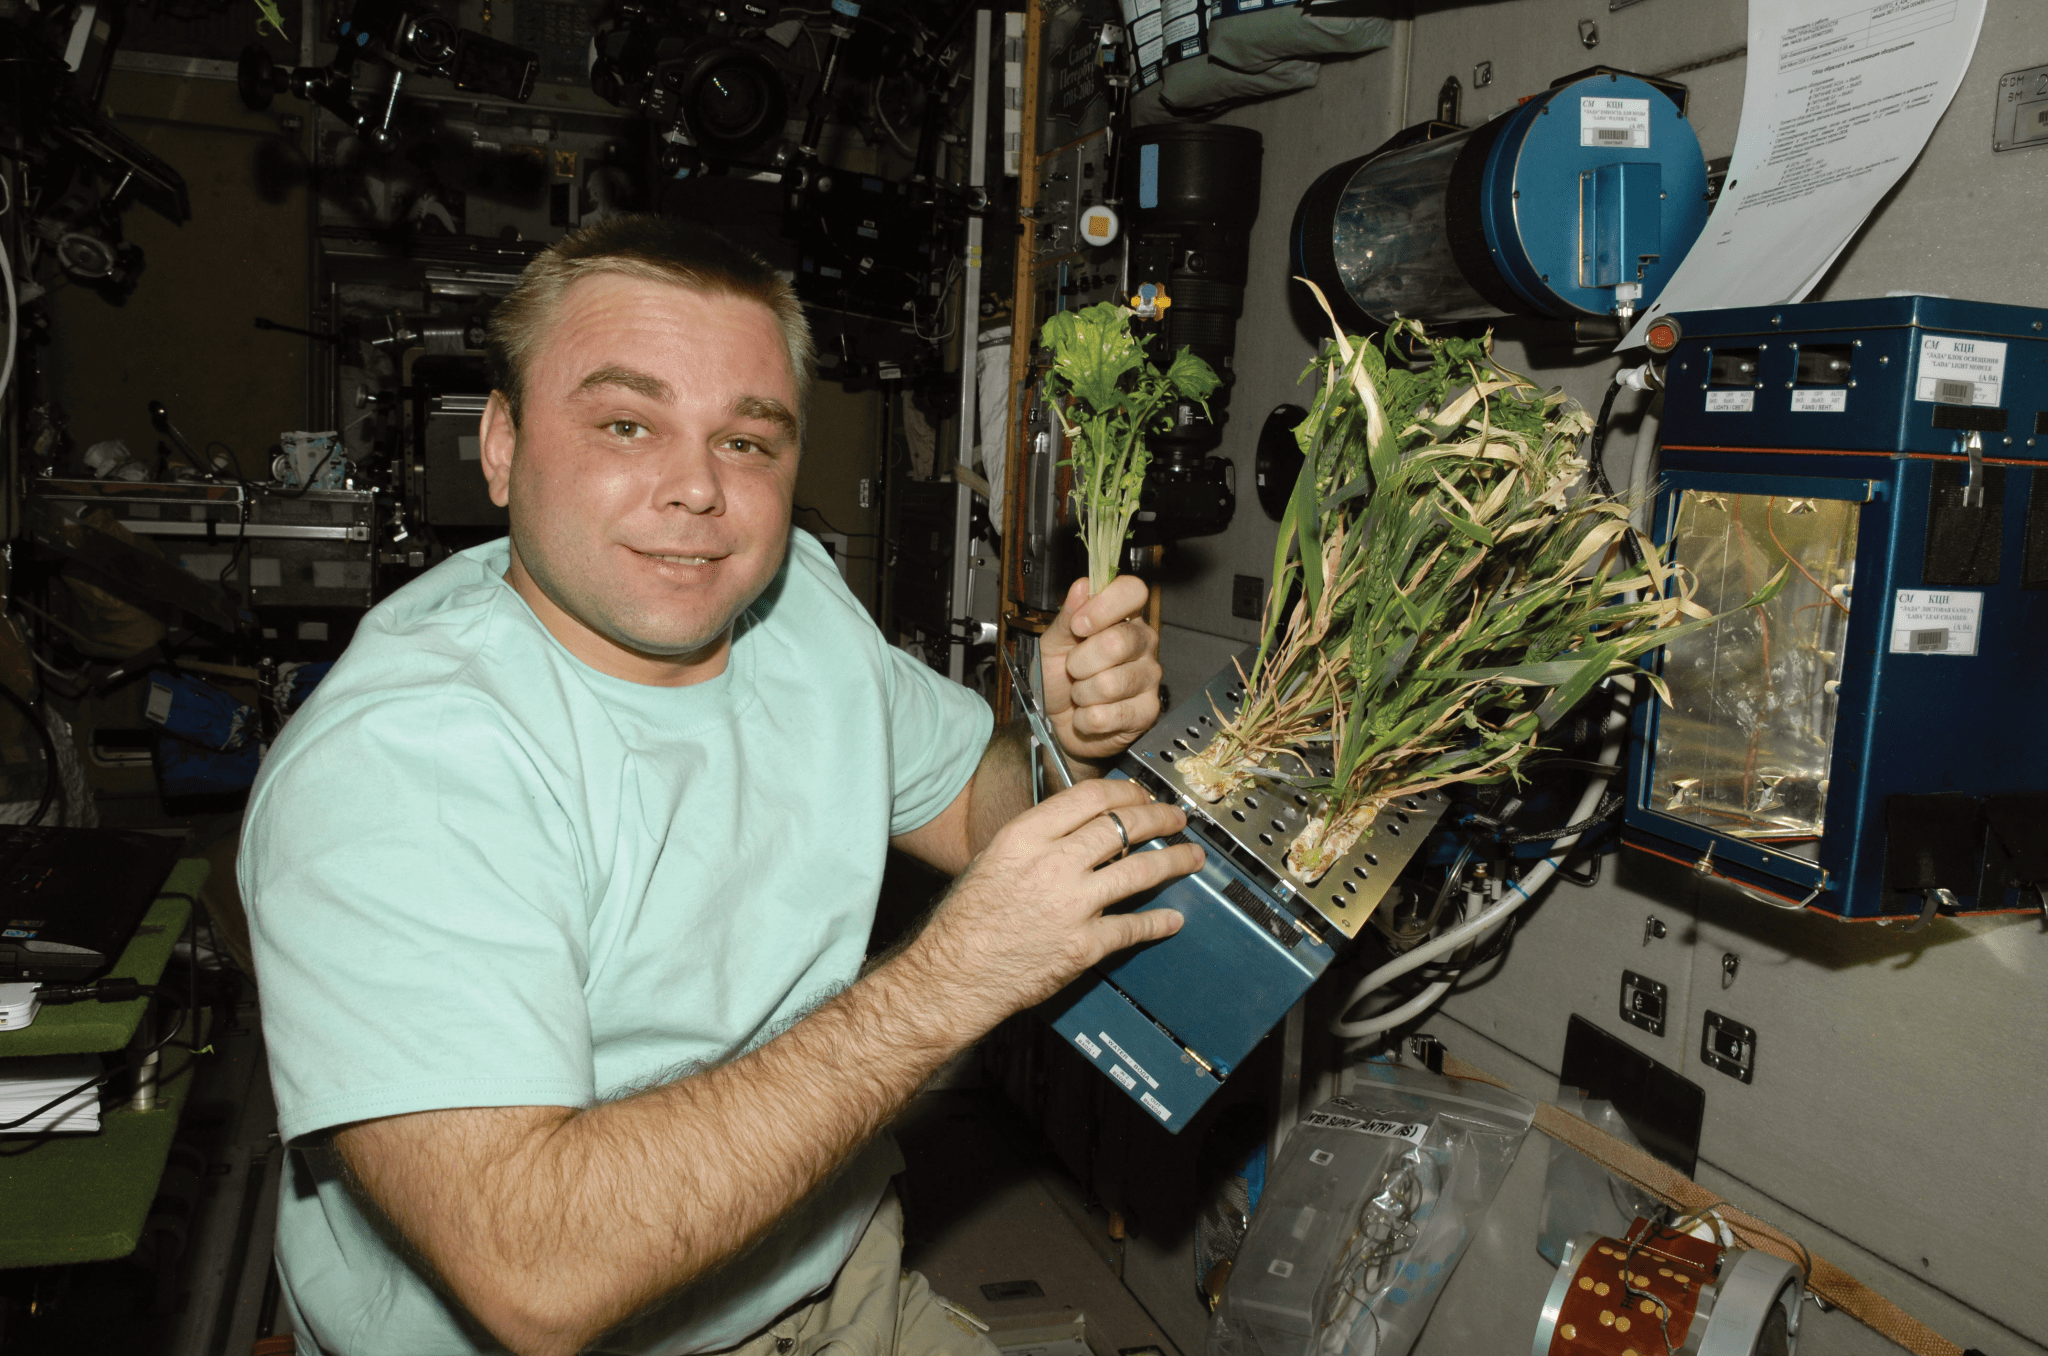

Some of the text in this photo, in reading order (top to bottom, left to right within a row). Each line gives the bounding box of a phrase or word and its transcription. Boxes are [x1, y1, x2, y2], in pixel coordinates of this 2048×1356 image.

[745, 4, 766, 15] Canon
[1063, 81, 1095, 108] 1703-2003
[1606, 101, 1623, 109] КЦН
[1924, 340, 1975, 353] СМ КЦН
[1963, 356, 1999, 364] ОСВЕЩЕНИЯ
[1899, 594, 1950, 605] СМ КЦН
[1078, 1039, 1091, 1053] ВХОД
[1108, 1040, 1128, 1060] WATER
[1133, 1064, 1150, 1081] ВОДА
[1112, 1070, 1127, 1085] ВХОД
[1326, 1116, 1361, 1128] SUPPLY
